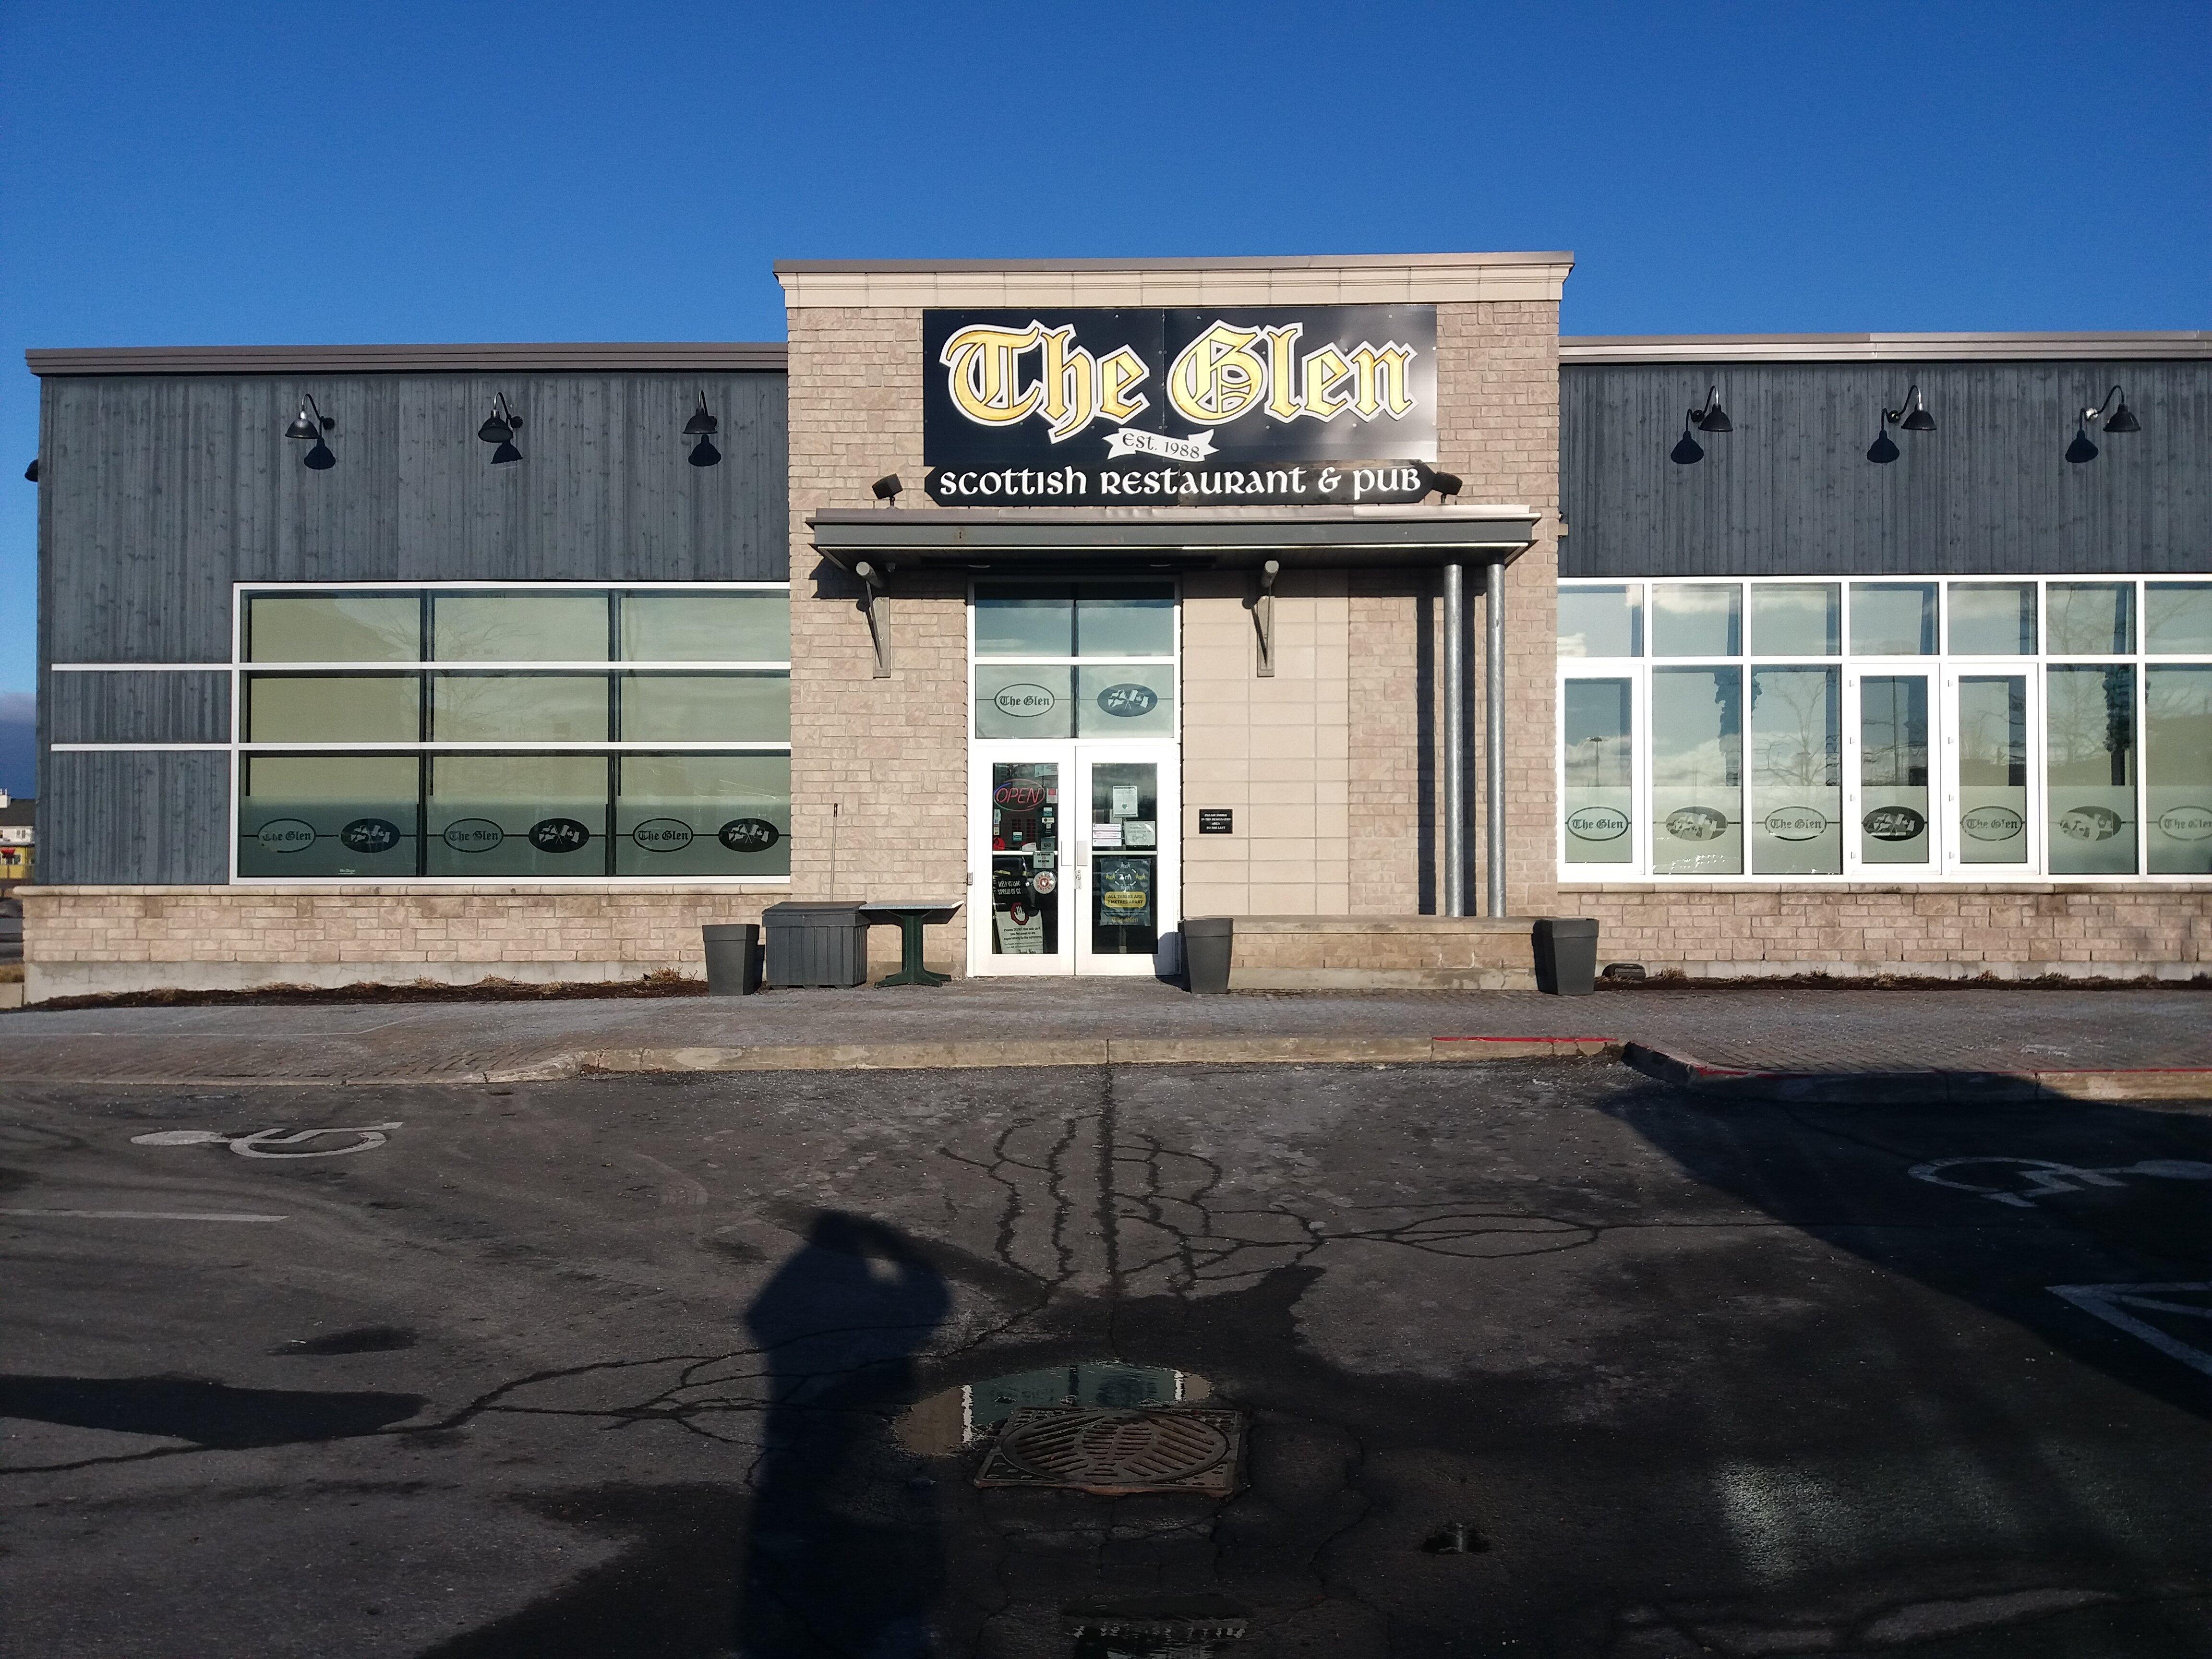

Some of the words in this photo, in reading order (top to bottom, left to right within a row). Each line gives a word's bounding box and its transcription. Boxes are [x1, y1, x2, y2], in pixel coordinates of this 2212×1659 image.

[939, 319, 1151, 444] The
[1166, 320, 1417, 425] Glen
[1164, 440, 1200, 459] 1988
[1318, 467, 1342, 493] &
[999, 695, 1021, 708] The
[1023, 695, 1050, 706] Glen
[996, 787, 1042, 803] OPEN
[1571, 818, 1594, 830] The
[1596, 818, 1623, 829] Glen
[1770, 818, 1792, 830] The
[1966, 818, 1988, 829] The
[262, 831, 283, 841] The
[285, 830, 311, 841] Glen
[449, 831, 469, 842] The
[472, 830, 498, 841] Glen
[637, 830, 660, 842] The
[661, 830, 688, 841] Glen
